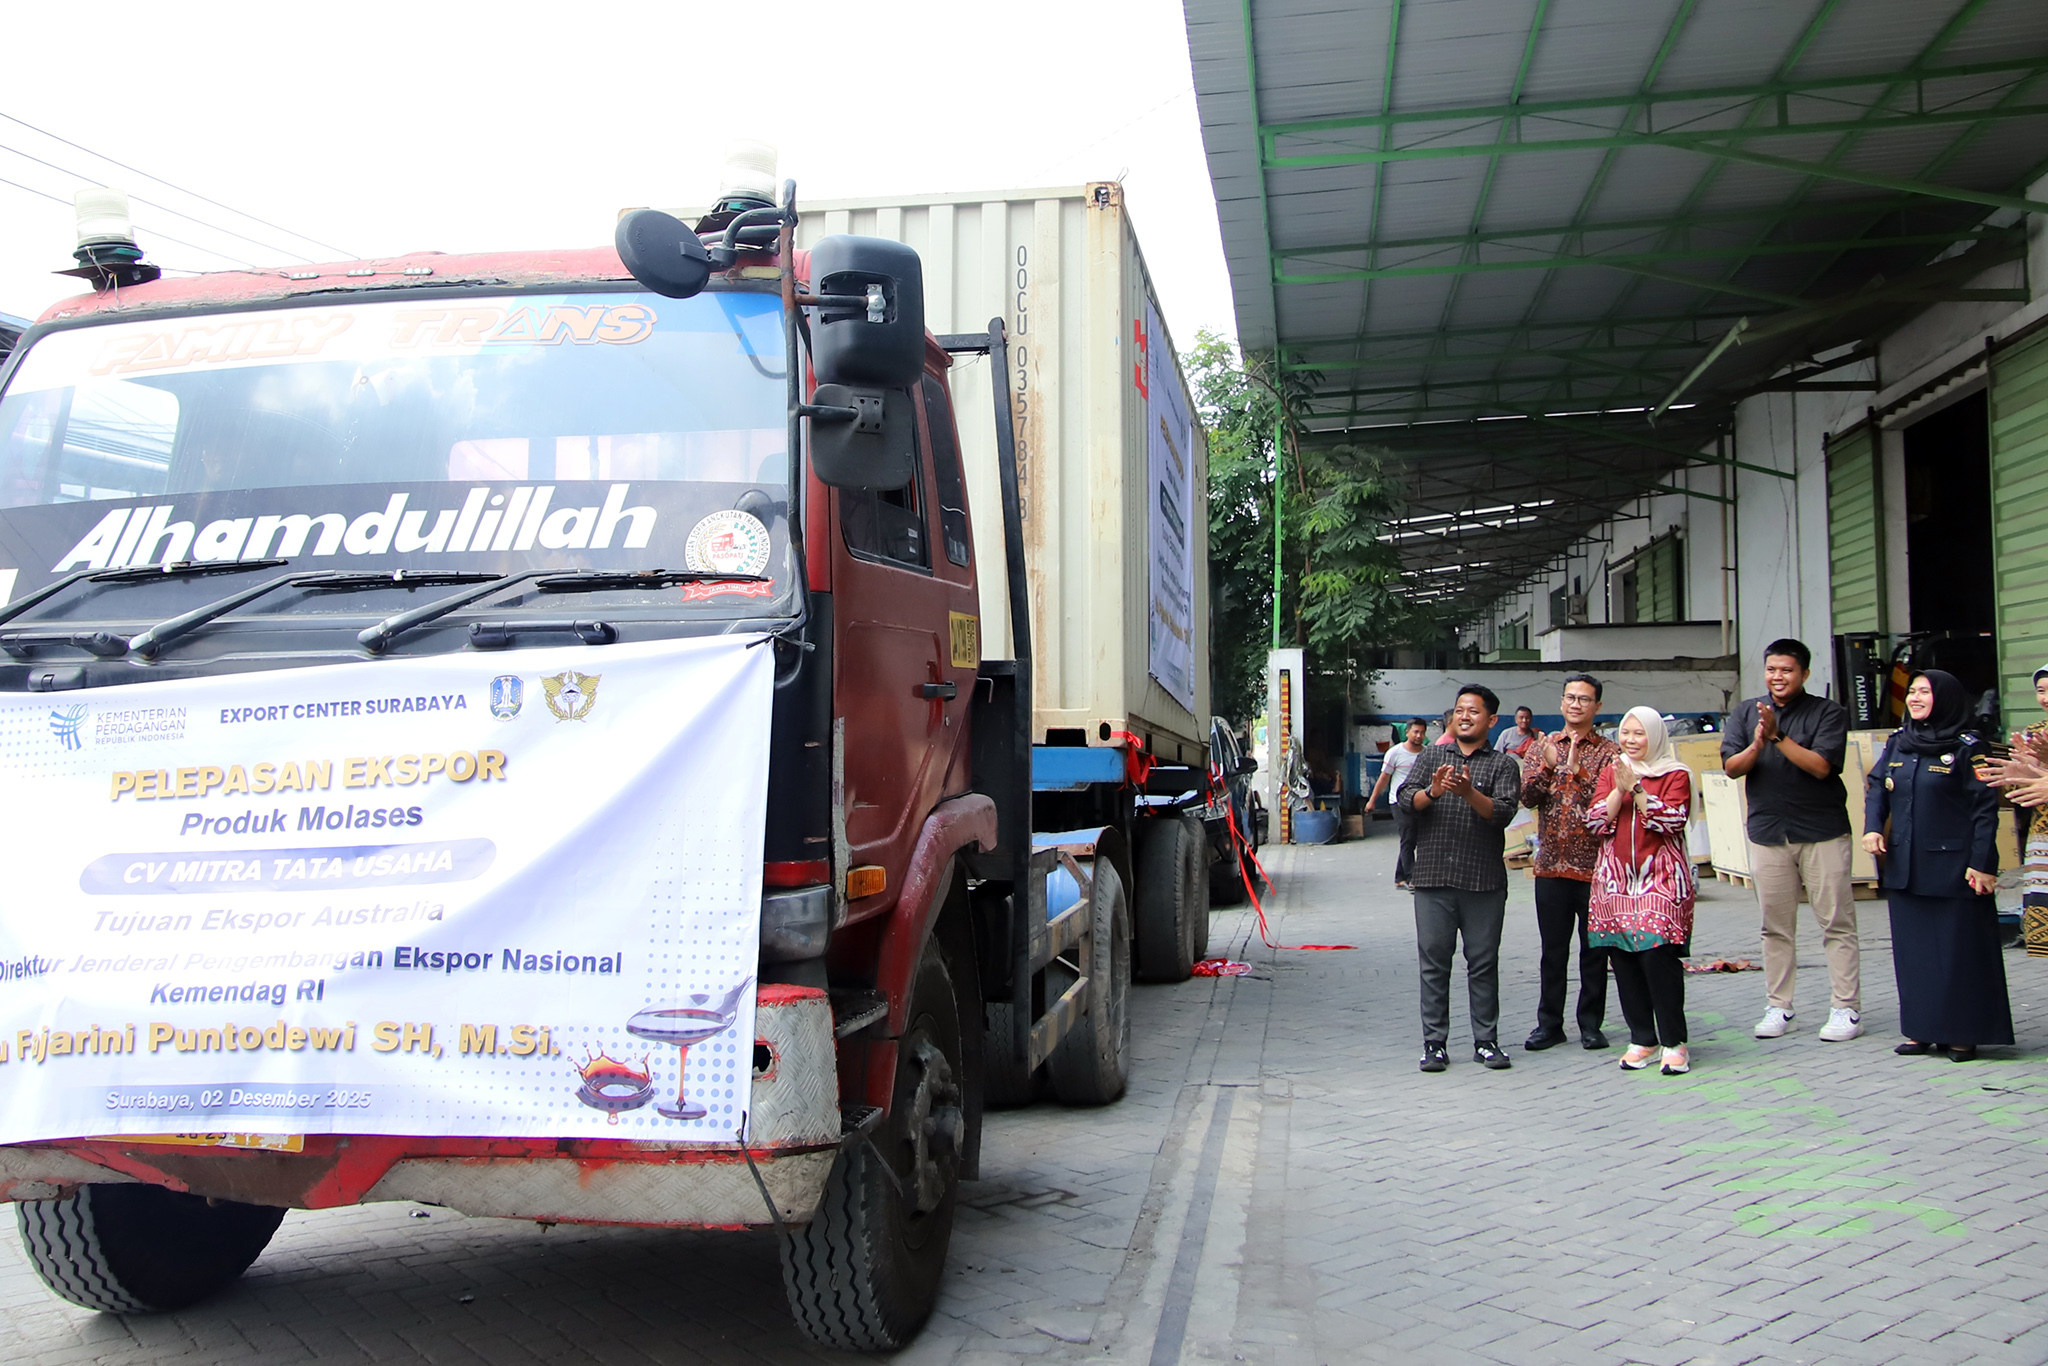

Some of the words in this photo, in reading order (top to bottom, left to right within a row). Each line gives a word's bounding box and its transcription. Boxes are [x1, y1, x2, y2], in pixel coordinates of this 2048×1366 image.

[88, 313, 355, 376] FAMILY
[388, 303, 657, 349] TRANS
[52, 483, 657, 573] Alhamdulillah
[220, 705, 290, 724] EXPORT
[294, 701, 362, 719] CENTER
[365, 694, 467, 715] SURABAYA
[1855, 675, 1869, 721] NICHIYU
[95, 720, 186, 737] PERDAGANGAN
[97, 707, 187, 723] KEMENTERIAN
[95, 735, 135, 745] REPUBLIK
[138, 732, 185, 742] INDONESIA
[110, 759, 331, 802] PELEPASAN
[342, 750, 508, 789] EKSPOR
[179, 808, 287, 836] Produk
[296, 804, 423, 832] Molases
[123, 861, 166, 884] CV
[169, 859, 262, 882] MITRA
[273, 856, 345, 880] TATA
[352, 850, 453, 876] USAHA
[94, 909, 192, 936] Tujuan
[199, 909, 305, 935] Ekspor
[312, 902, 444, 928] Australia
[68, 953, 179, 974] Jenderal
[184, 949, 383, 973] Pengembangan
[394, 946, 493, 974] Ekspor
[502, 948, 622, 974] Nasional
[149, 981, 287, 1006] Kemendag
[296, 979, 325, 1001] RI
[148, 1020, 356, 1053] Puntodewi
[370, 1021, 442, 1059] SH,
[459, 1023, 560, 1056] M.Si.
[105, 1090, 195, 1111] Surabaya,
[200, 1090, 224, 1107] 02
[228, 1088, 322, 1109] Desember
[324, 1091, 372, 1108] 2025
